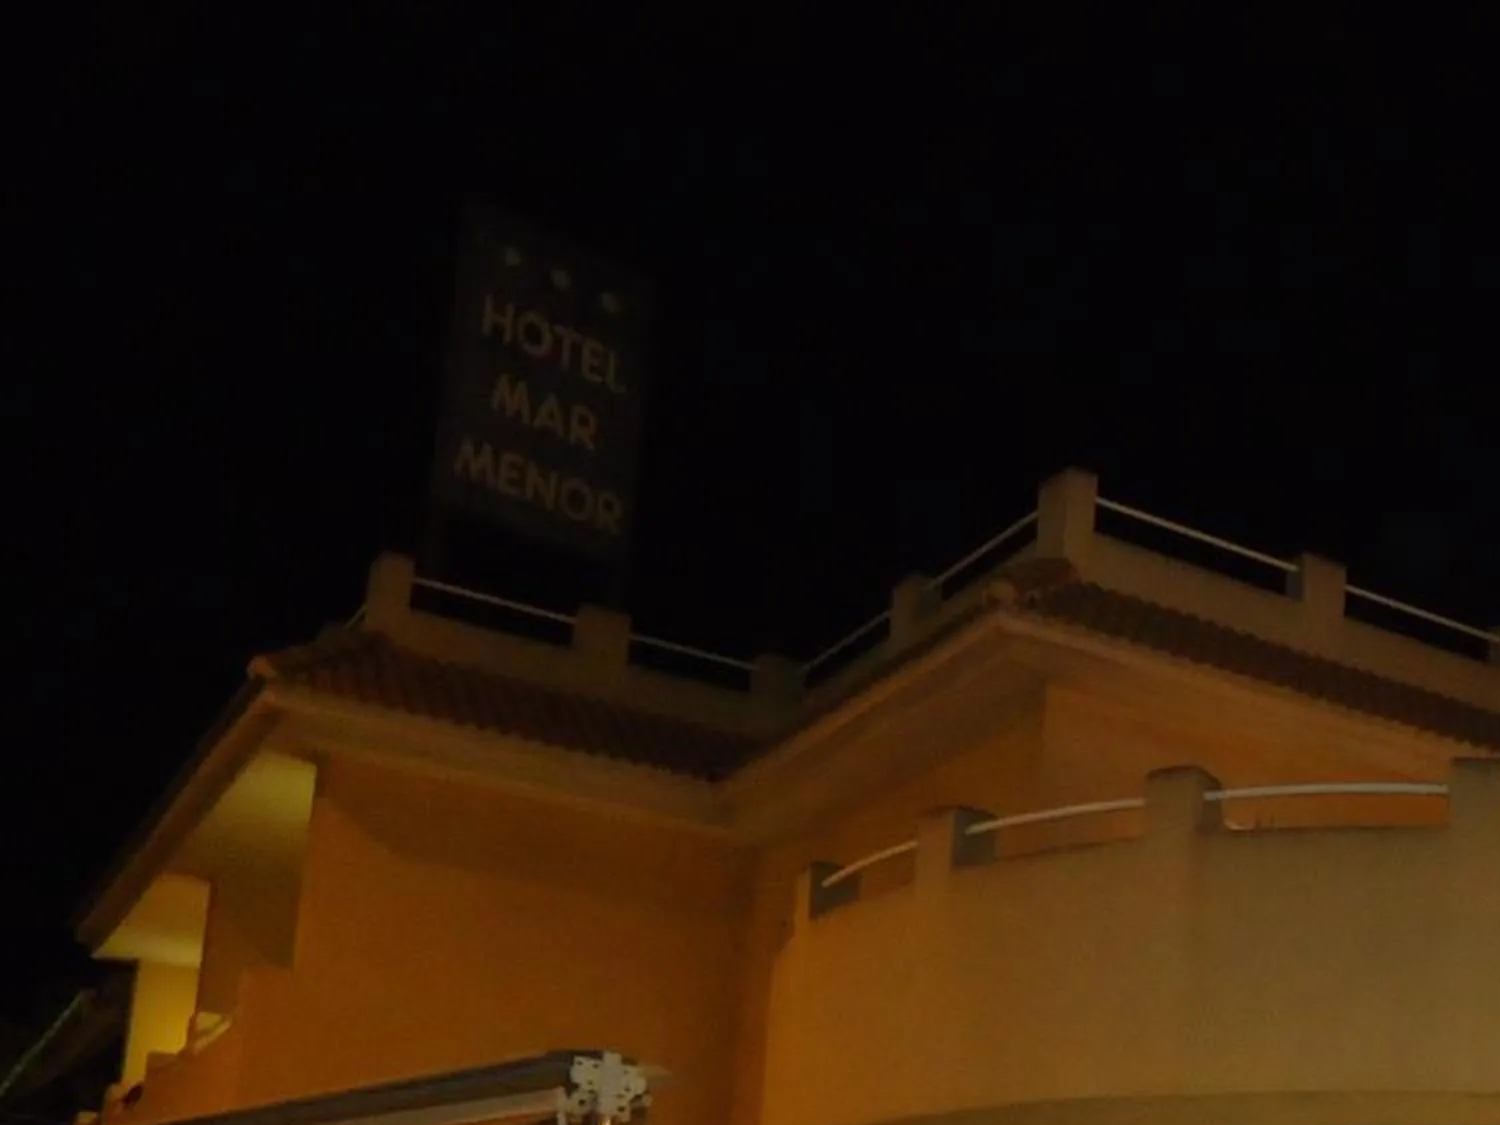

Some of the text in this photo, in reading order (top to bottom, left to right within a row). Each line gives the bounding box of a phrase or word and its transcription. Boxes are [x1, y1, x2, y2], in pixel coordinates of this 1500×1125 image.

[482, 294, 628, 394] HOTEL
[491, 373, 598, 451] MAR
[453, 437, 625, 535] MENOR
